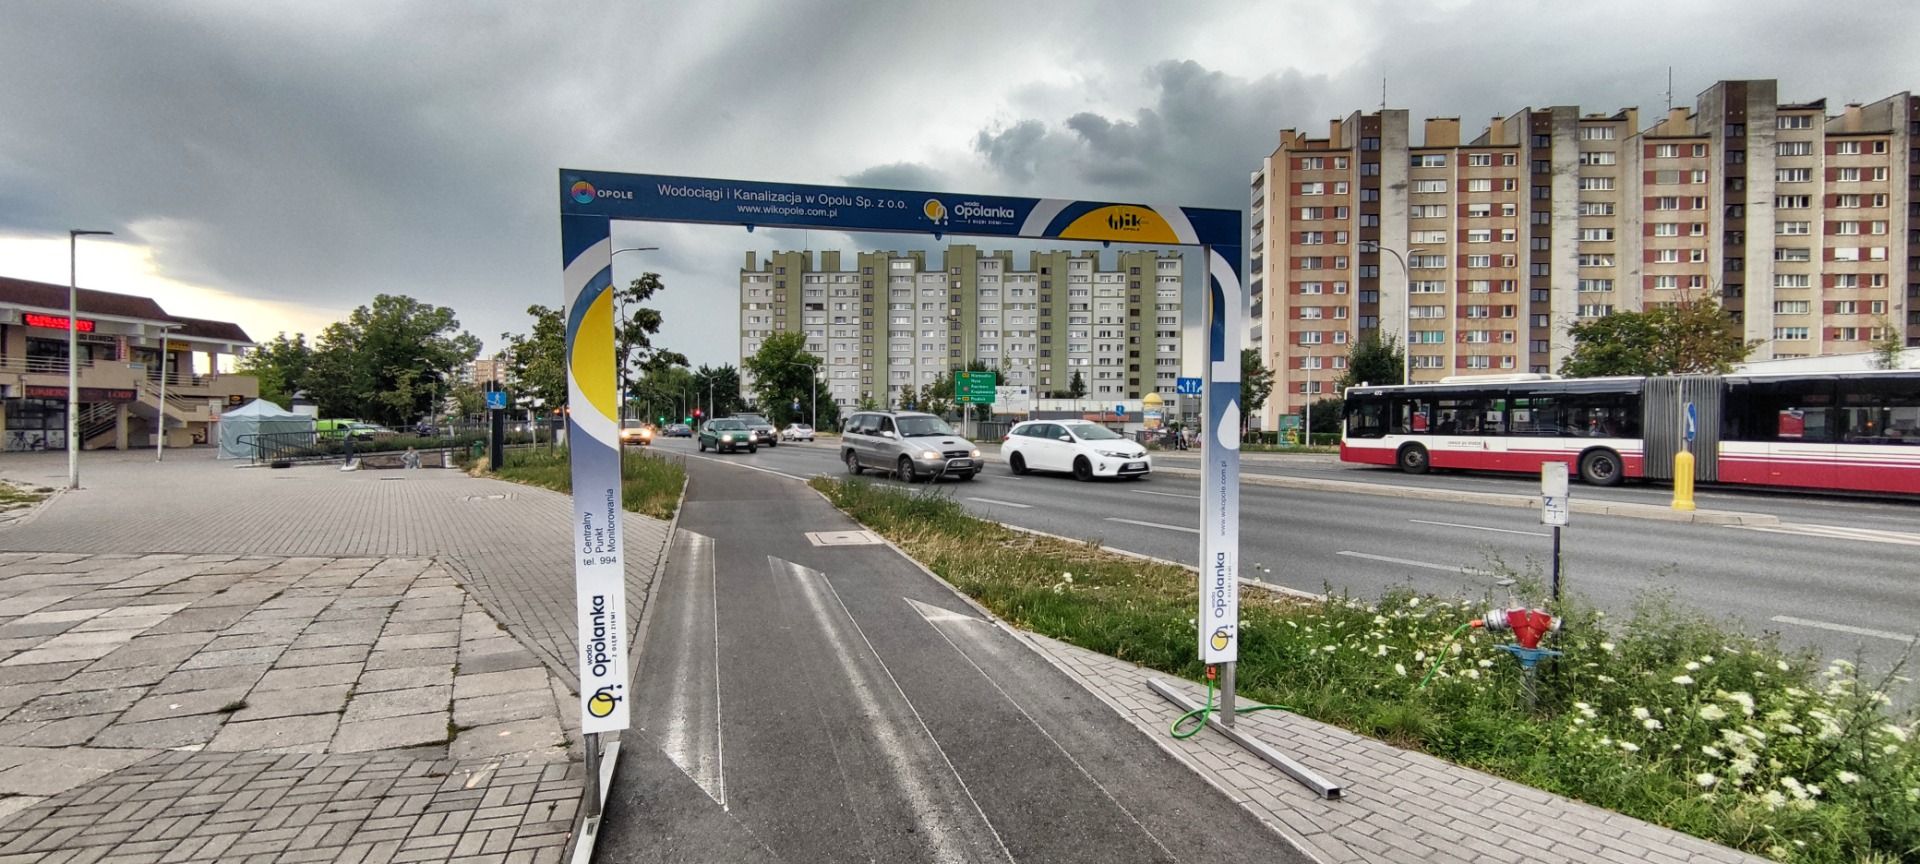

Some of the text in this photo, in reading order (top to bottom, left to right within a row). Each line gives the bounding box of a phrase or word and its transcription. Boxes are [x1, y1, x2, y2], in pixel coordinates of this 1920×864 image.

[597, 189, 633, 200] OPOLE
[657, 184, 908, 209] Wodociągi i Kanalizacja w Opolu Sp. z o.o.
[737, 204, 838, 217] www.wikopole.com.pl
[954, 204, 1015, 219] Opolanka
[1220, 460, 1228, 537] www.wikopole.com.pl
[583, 511, 593, 554] Centralny
[605, 488, 616, 553] Monitorowania
[594, 527, 604, 553] Punkt
[583, 556, 617, 566] tel. 994
[1215, 552, 1227, 618] Opolanka
[589, 594, 612, 677] Opolanka
